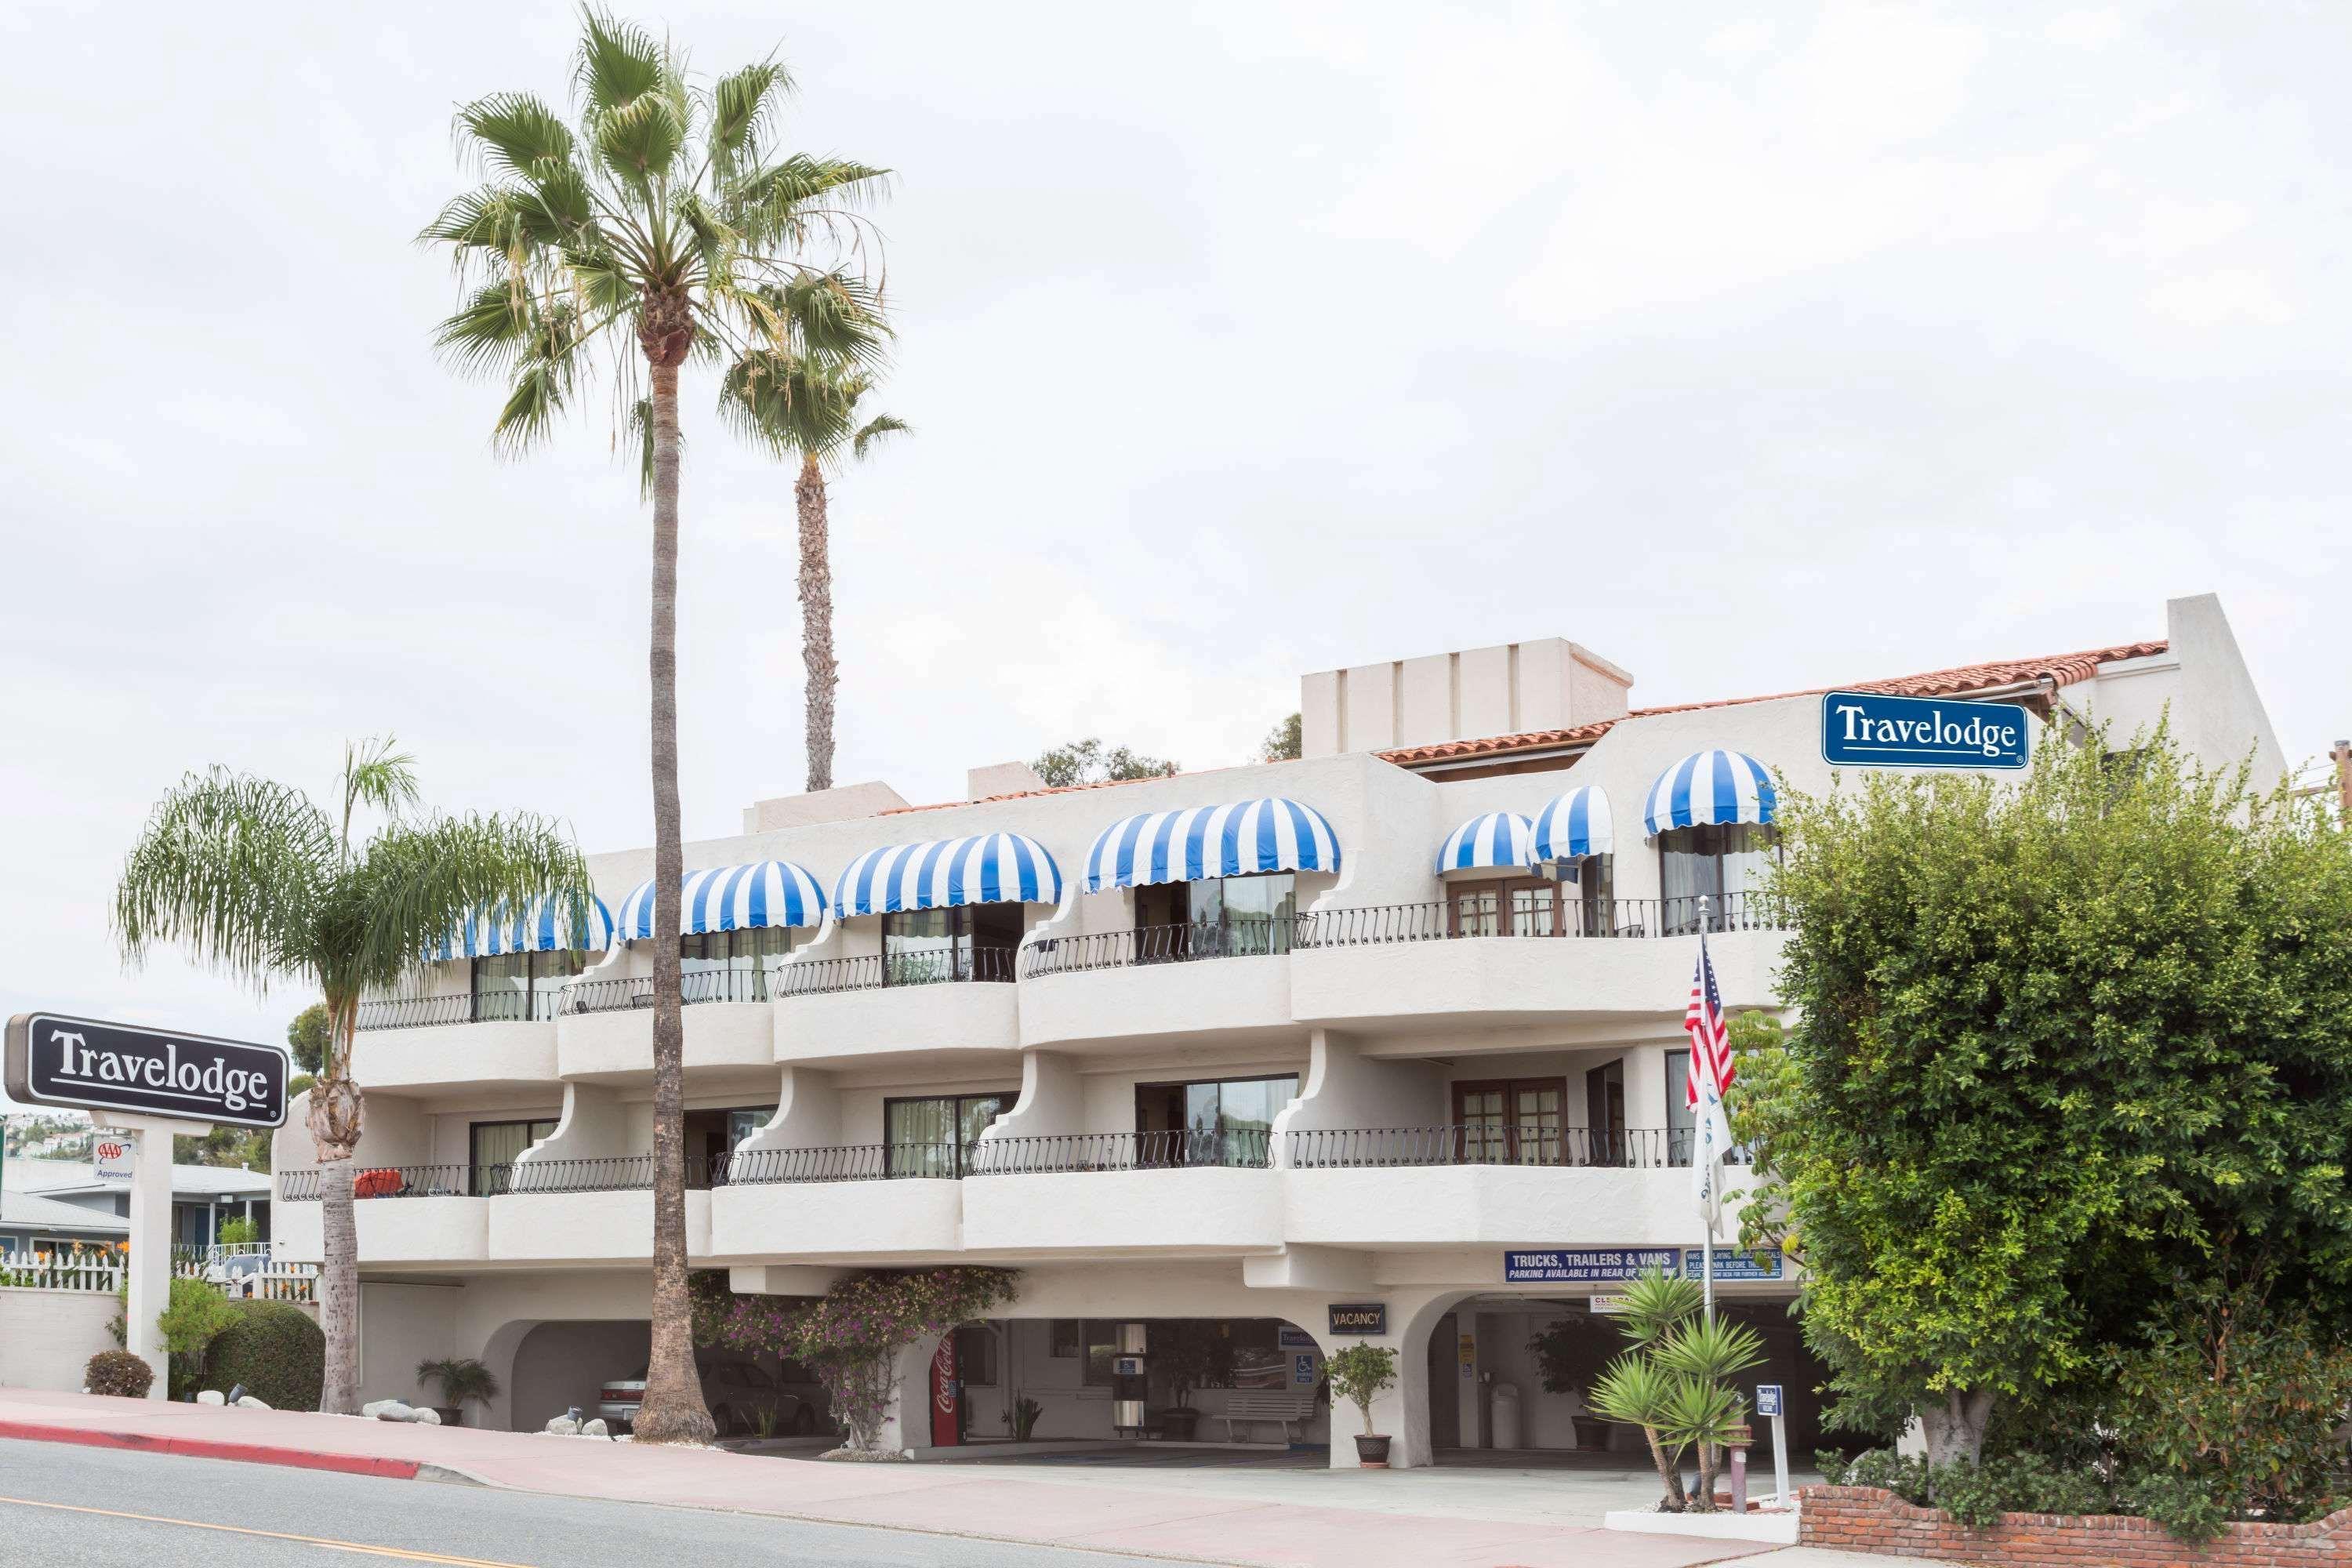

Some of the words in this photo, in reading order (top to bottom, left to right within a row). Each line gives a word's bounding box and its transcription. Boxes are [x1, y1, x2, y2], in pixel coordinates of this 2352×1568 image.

[1835, 704, 2016, 757] Travelodge
[50, 1029, 268, 1111] Travelodge
[100, 1143, 120, 1159] AAA
[97, 1170, 132, 1178] Approved
[1513, 1254, 1563, 1268] TRUCKS,
[1566, 1254, 1621, 1266] TRAILERS
[1626, 1254, 1635, 1266] &
[1639, 1253, 1671, 1265] VANS
[1509, 1269, 1543, 1279] PARKING
[1545, 1269, 1588, 1278] AVAILABLE
[1591, 1269, 1599, 1277] IN
[1601, 1269, 1623, 1277] REAR
[1625, 1268, 1637, 1277] OF
[1333, 1312, 1380, 1325] VACANCY
